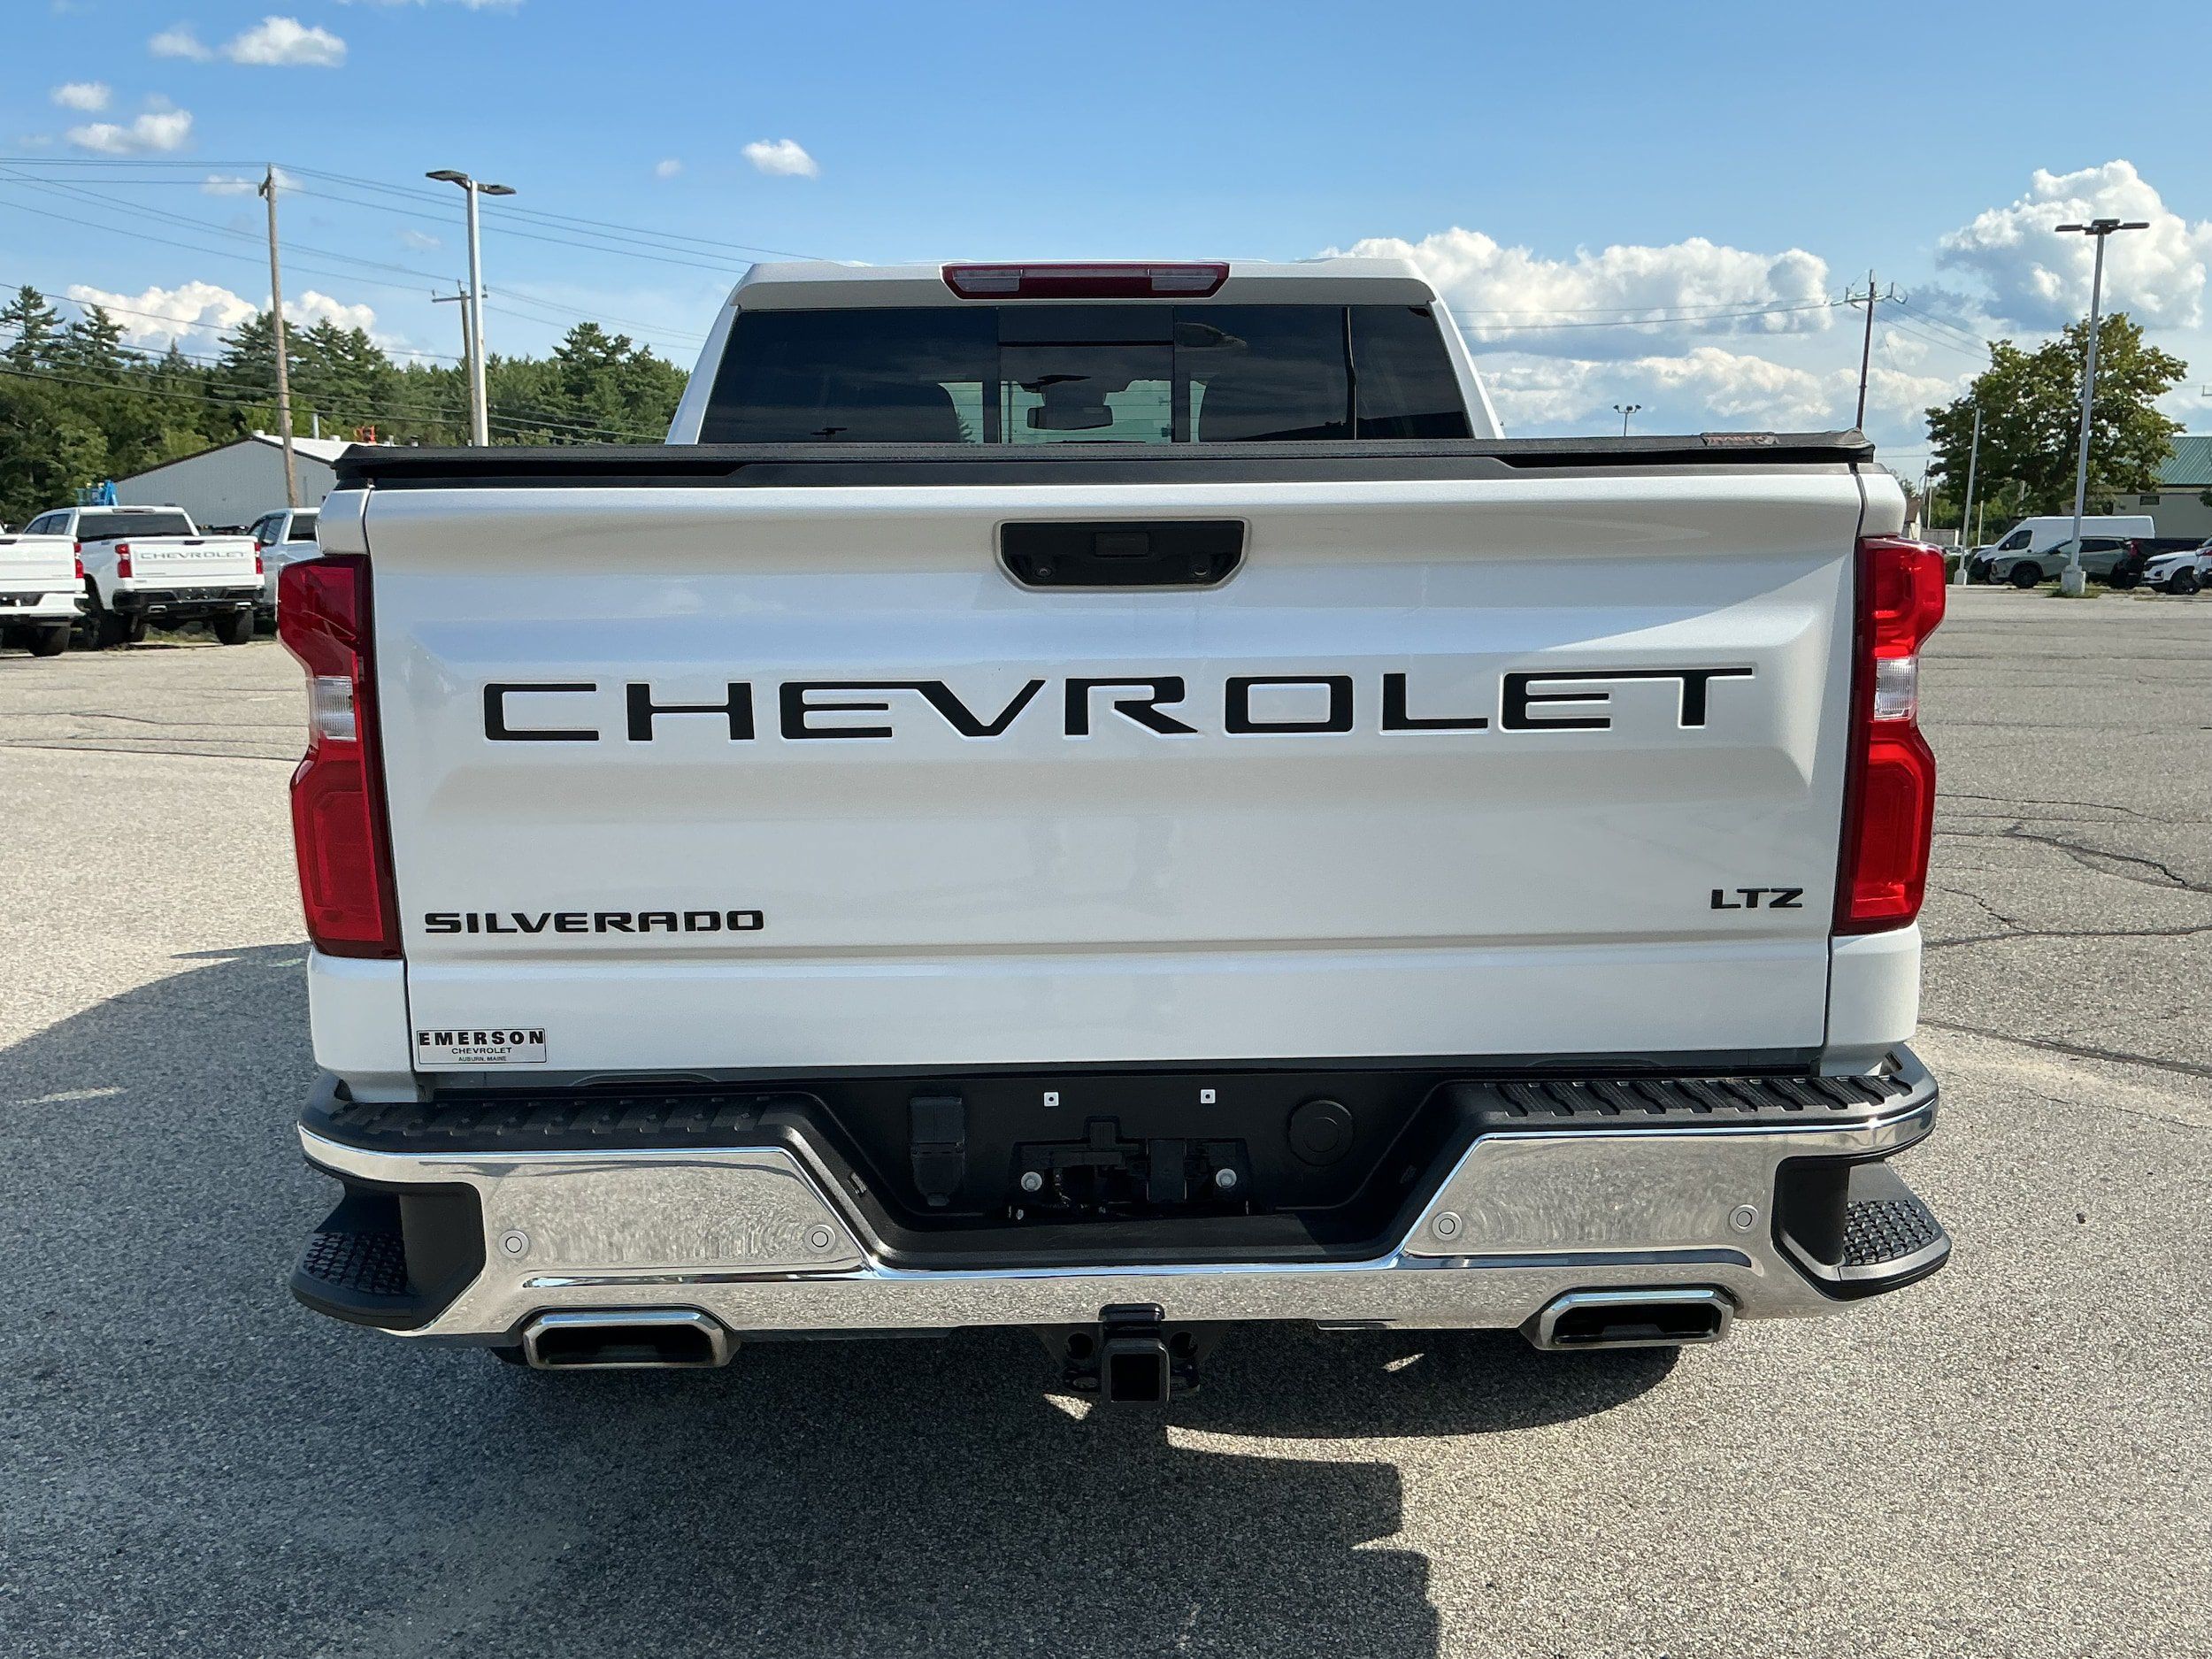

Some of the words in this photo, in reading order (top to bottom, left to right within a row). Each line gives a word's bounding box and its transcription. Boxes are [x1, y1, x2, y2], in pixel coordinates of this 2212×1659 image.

[483, 667, 1753, 741] CHEVROLET
[1710, 887, 1804, 910] LTZ
[425, 910, 764, 933] SILVERADO
[419, 1031, 544, 1046] EMERSON
